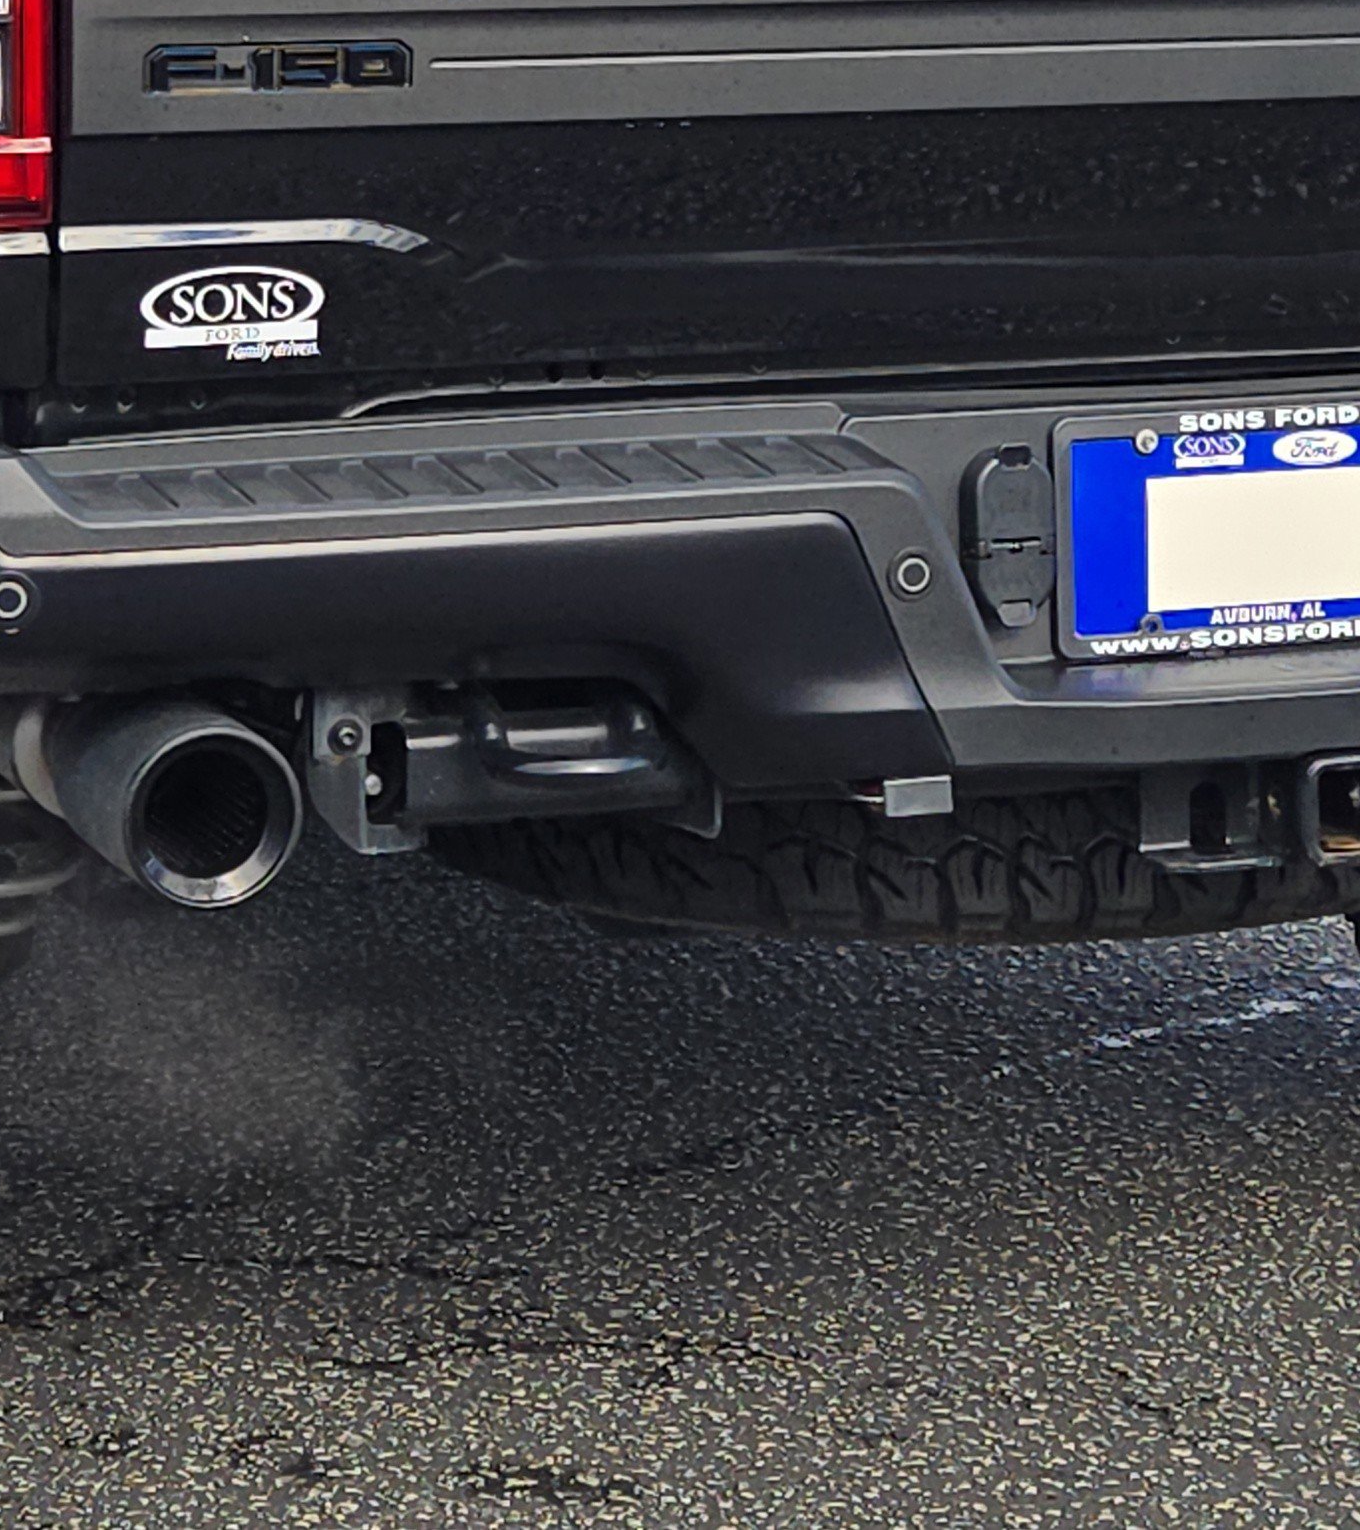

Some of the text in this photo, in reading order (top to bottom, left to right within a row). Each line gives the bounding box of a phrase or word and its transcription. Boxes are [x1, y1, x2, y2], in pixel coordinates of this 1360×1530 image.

[143, 39, 414, 94] F-150
[169, 280, 296, 325] SONS
[204, 326, 262, 343] FORD
[1178, 404, 1360, 433] SONS FORD
[1183, 434, 1236, 456] SONS
[1290, 436, 1340, 458] Ford
[1209, 600, 1326, 626] AUBURN, AL
